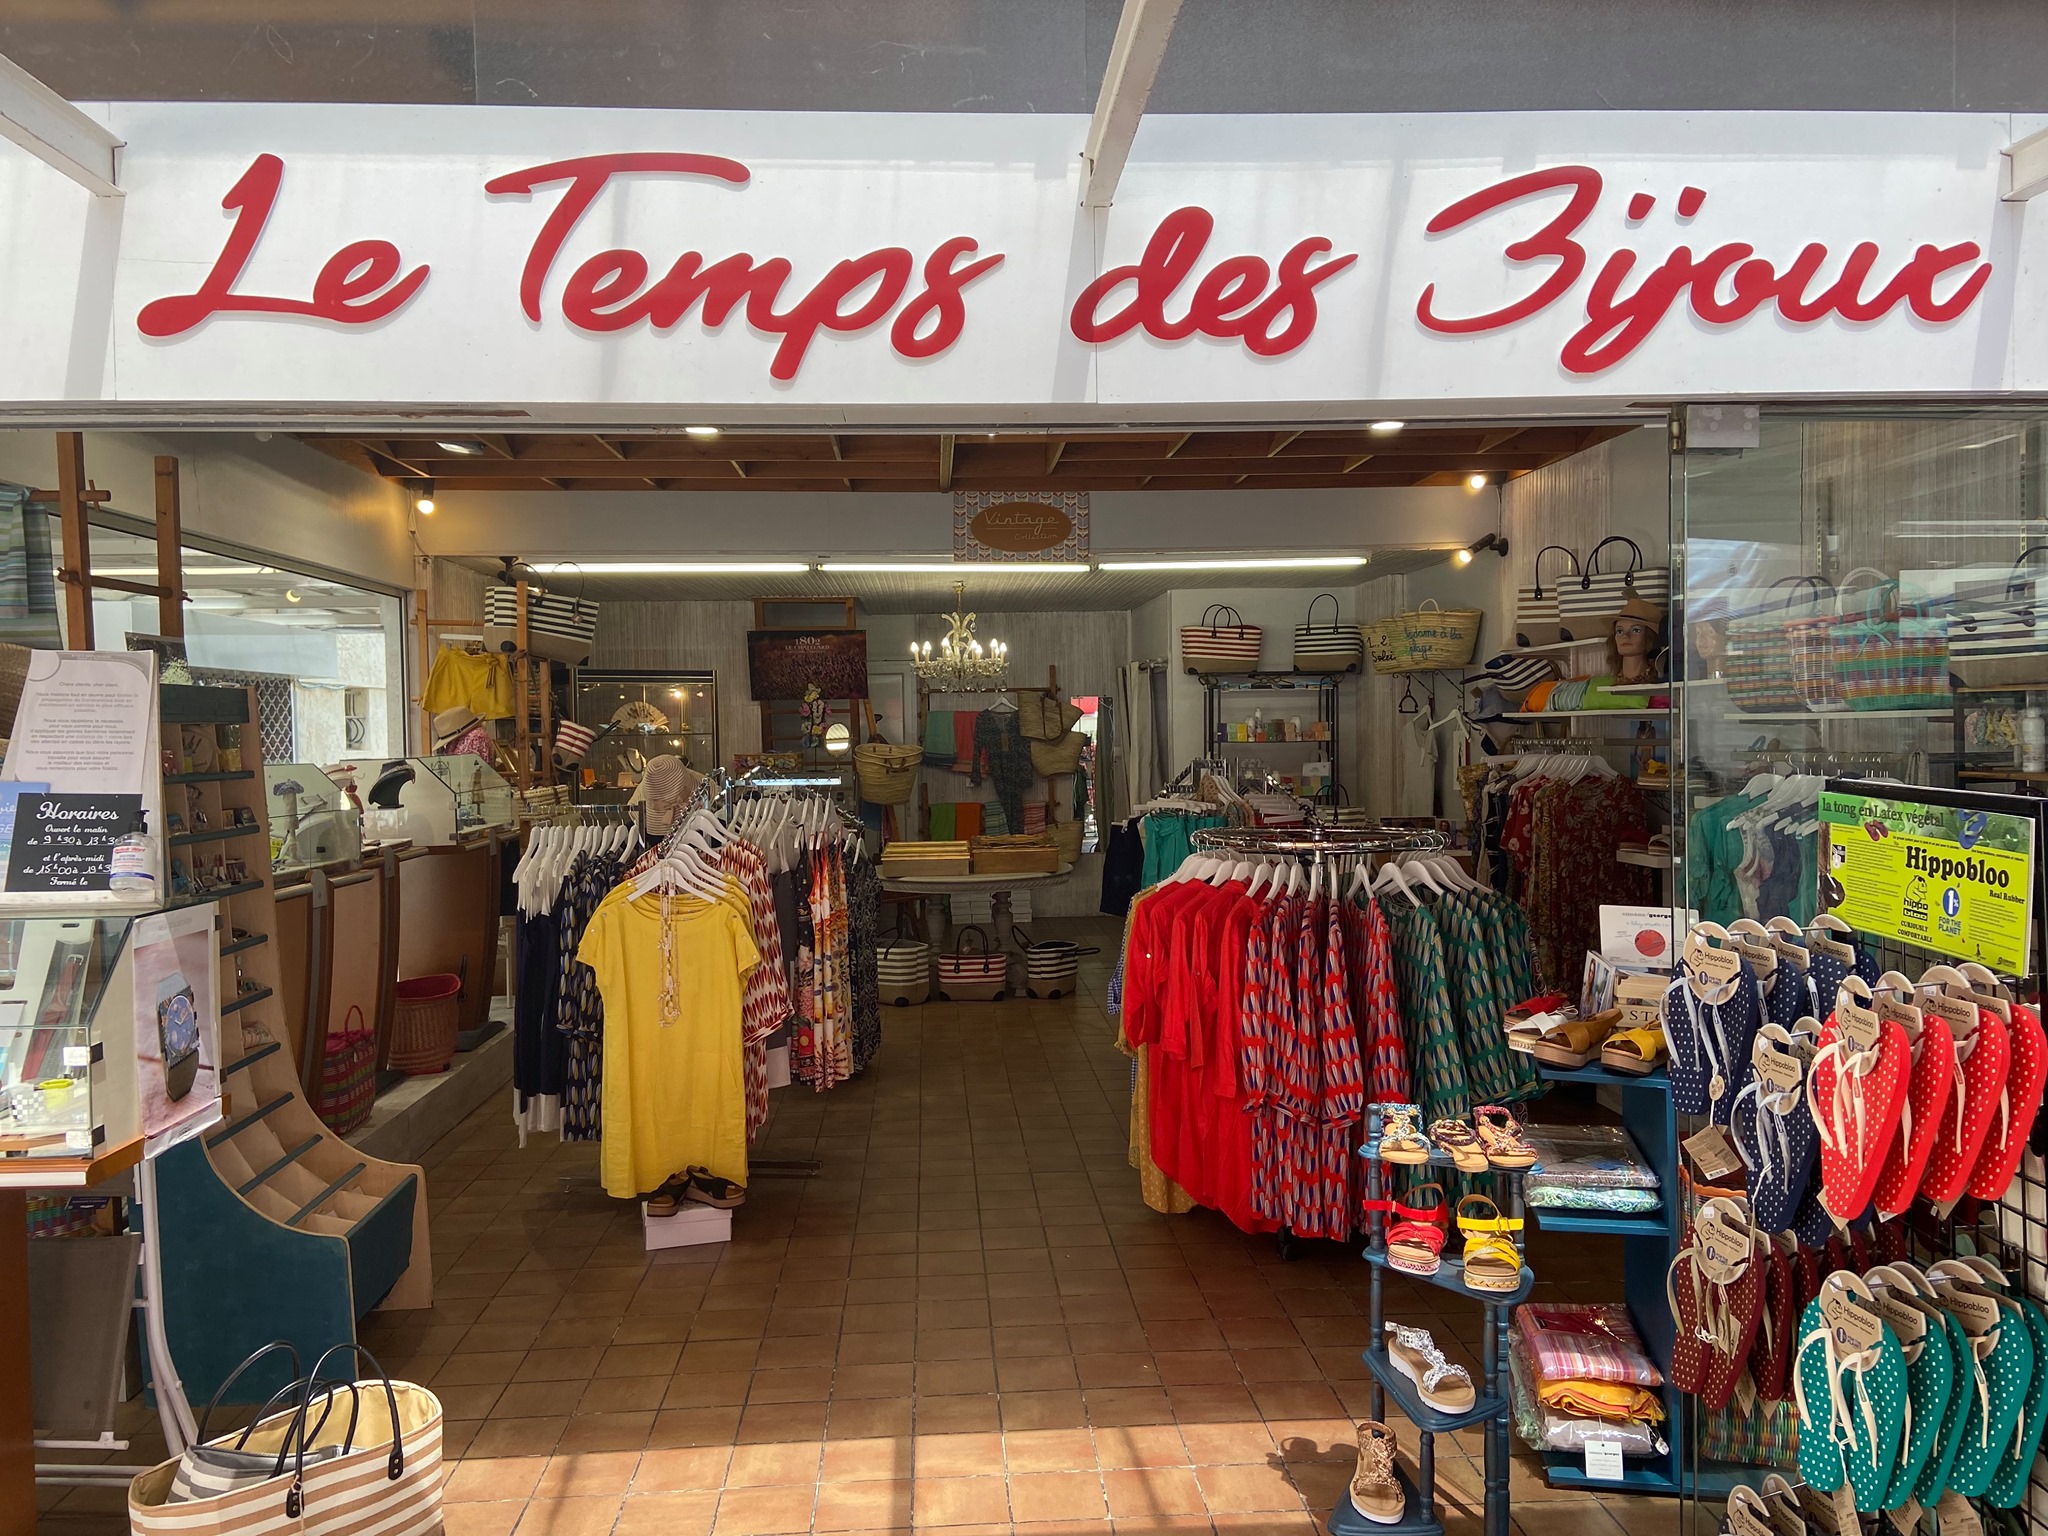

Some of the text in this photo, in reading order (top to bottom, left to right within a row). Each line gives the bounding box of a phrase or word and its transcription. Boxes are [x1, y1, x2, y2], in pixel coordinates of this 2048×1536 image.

[137, 152, 1992, 380] Le Temps des Bijoux
[984, 511, 1060, 535] Vintage
[1015, 533, 1058, 541] Collection
[795, 636, 821, 646] 1802
[36, 801, 119, 820] Horaires
[1822, 797, 1945, 828] la tong en Latex végétal
[45, 824, 108, 833] Ouvert le matin
[43, 854, 51, 862] et
[53, 852, 105, 864] l'après-midi
[23, 866, 34, 874] de
[73, 866, 79, 874] à
[1905, 845, 2010, 889] Hippobloo
[50, 876, 88, 887] Fermé le
[1903, 897, 1928, 911] hippo
[1989, 889, 2026, 905] Real Rubber
[1904, 909, 1928, 920] bloo
[1939, 916, 1962, 927] FOR THE
[1938, 923, 1962, 935] PLANET
[1704, 951, 1734, 965] Hippobloo
[1742, 949, 1771, 962] Hippobloo
[1777, 946, 1804, 961] Hippobloo
[1823, 945, 1849, 958] Hippobloo
[1890, 1007, 1916, 1024] Hippobloo
[1938, 1001, 1971, 1017] Hippobloo
[1851, 1011, 1874, 1029] Hippobloo
[1770, 1056, 1796, 1073] Hippobloo
[1716, 1227, 1744, 1249] Hippobloo
[1949, 1296, 1990, 1314] Hippobloo
[1843, 1305, 1876, 1331] Hippobloo
[1883, 1301, 1918, 1325] Hippobloo
